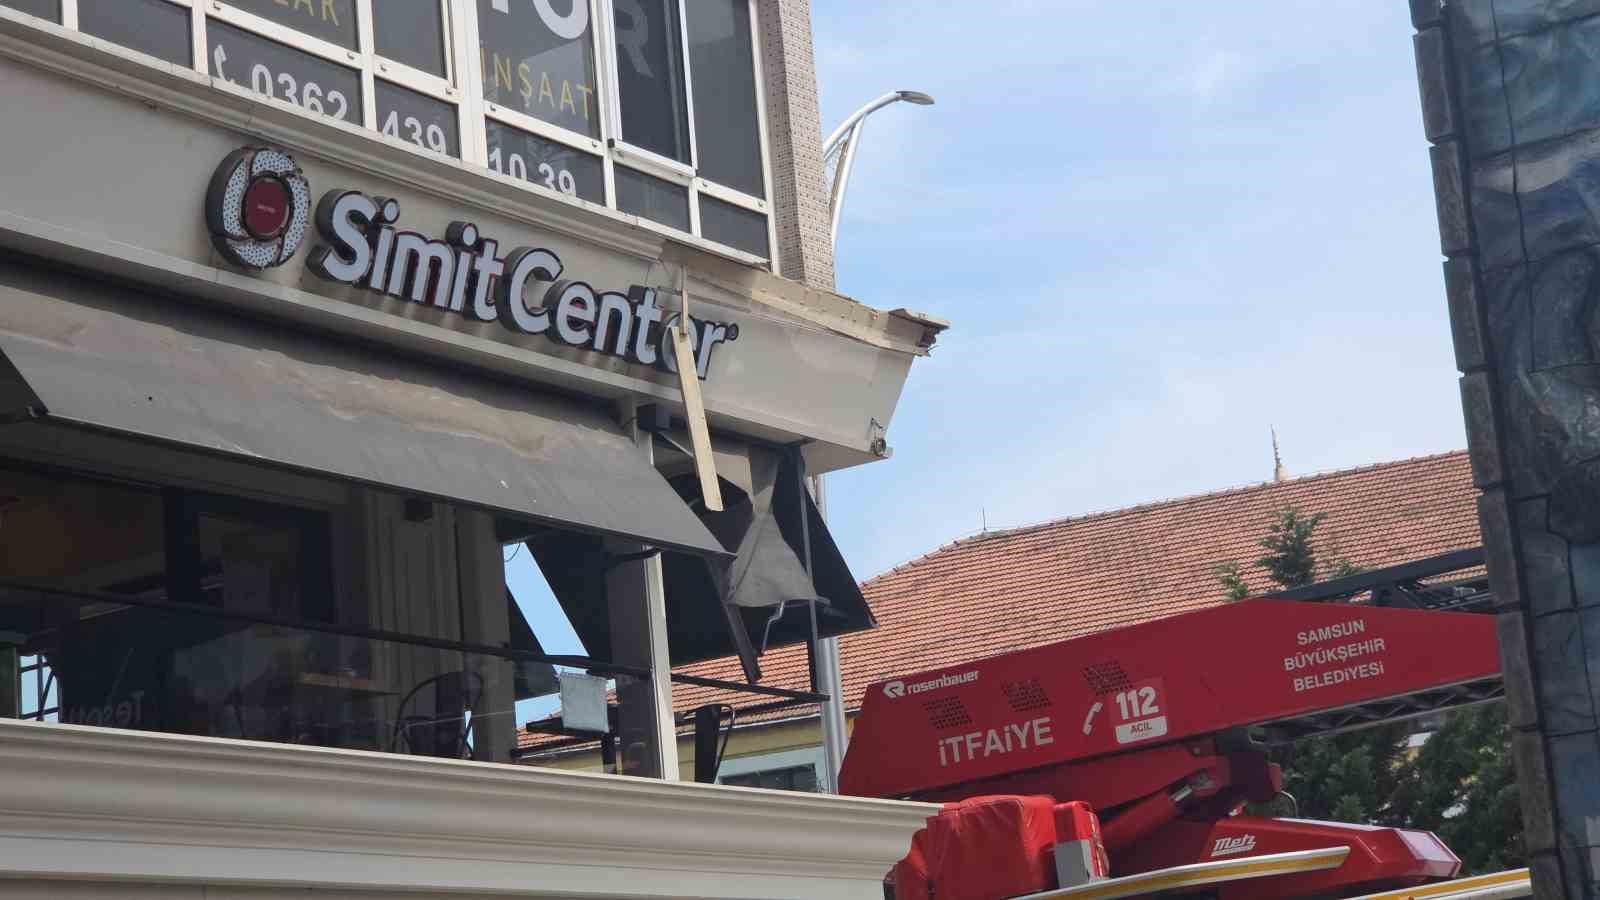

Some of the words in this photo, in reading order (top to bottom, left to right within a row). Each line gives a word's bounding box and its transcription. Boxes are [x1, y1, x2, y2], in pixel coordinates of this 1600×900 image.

[251, 63, 348, 121] 0362
[382, 110, 447, 154] 439
[489, 147, 527, 182] 10
[538, 162, 576, 197] 39
[1297, 619, 1365, 645] SAMSUN
[906, 670, 979, 695] rosenbauer
[1116, 687, 1159, 720] 112
[1213, 834, 1257, 854] Metz
